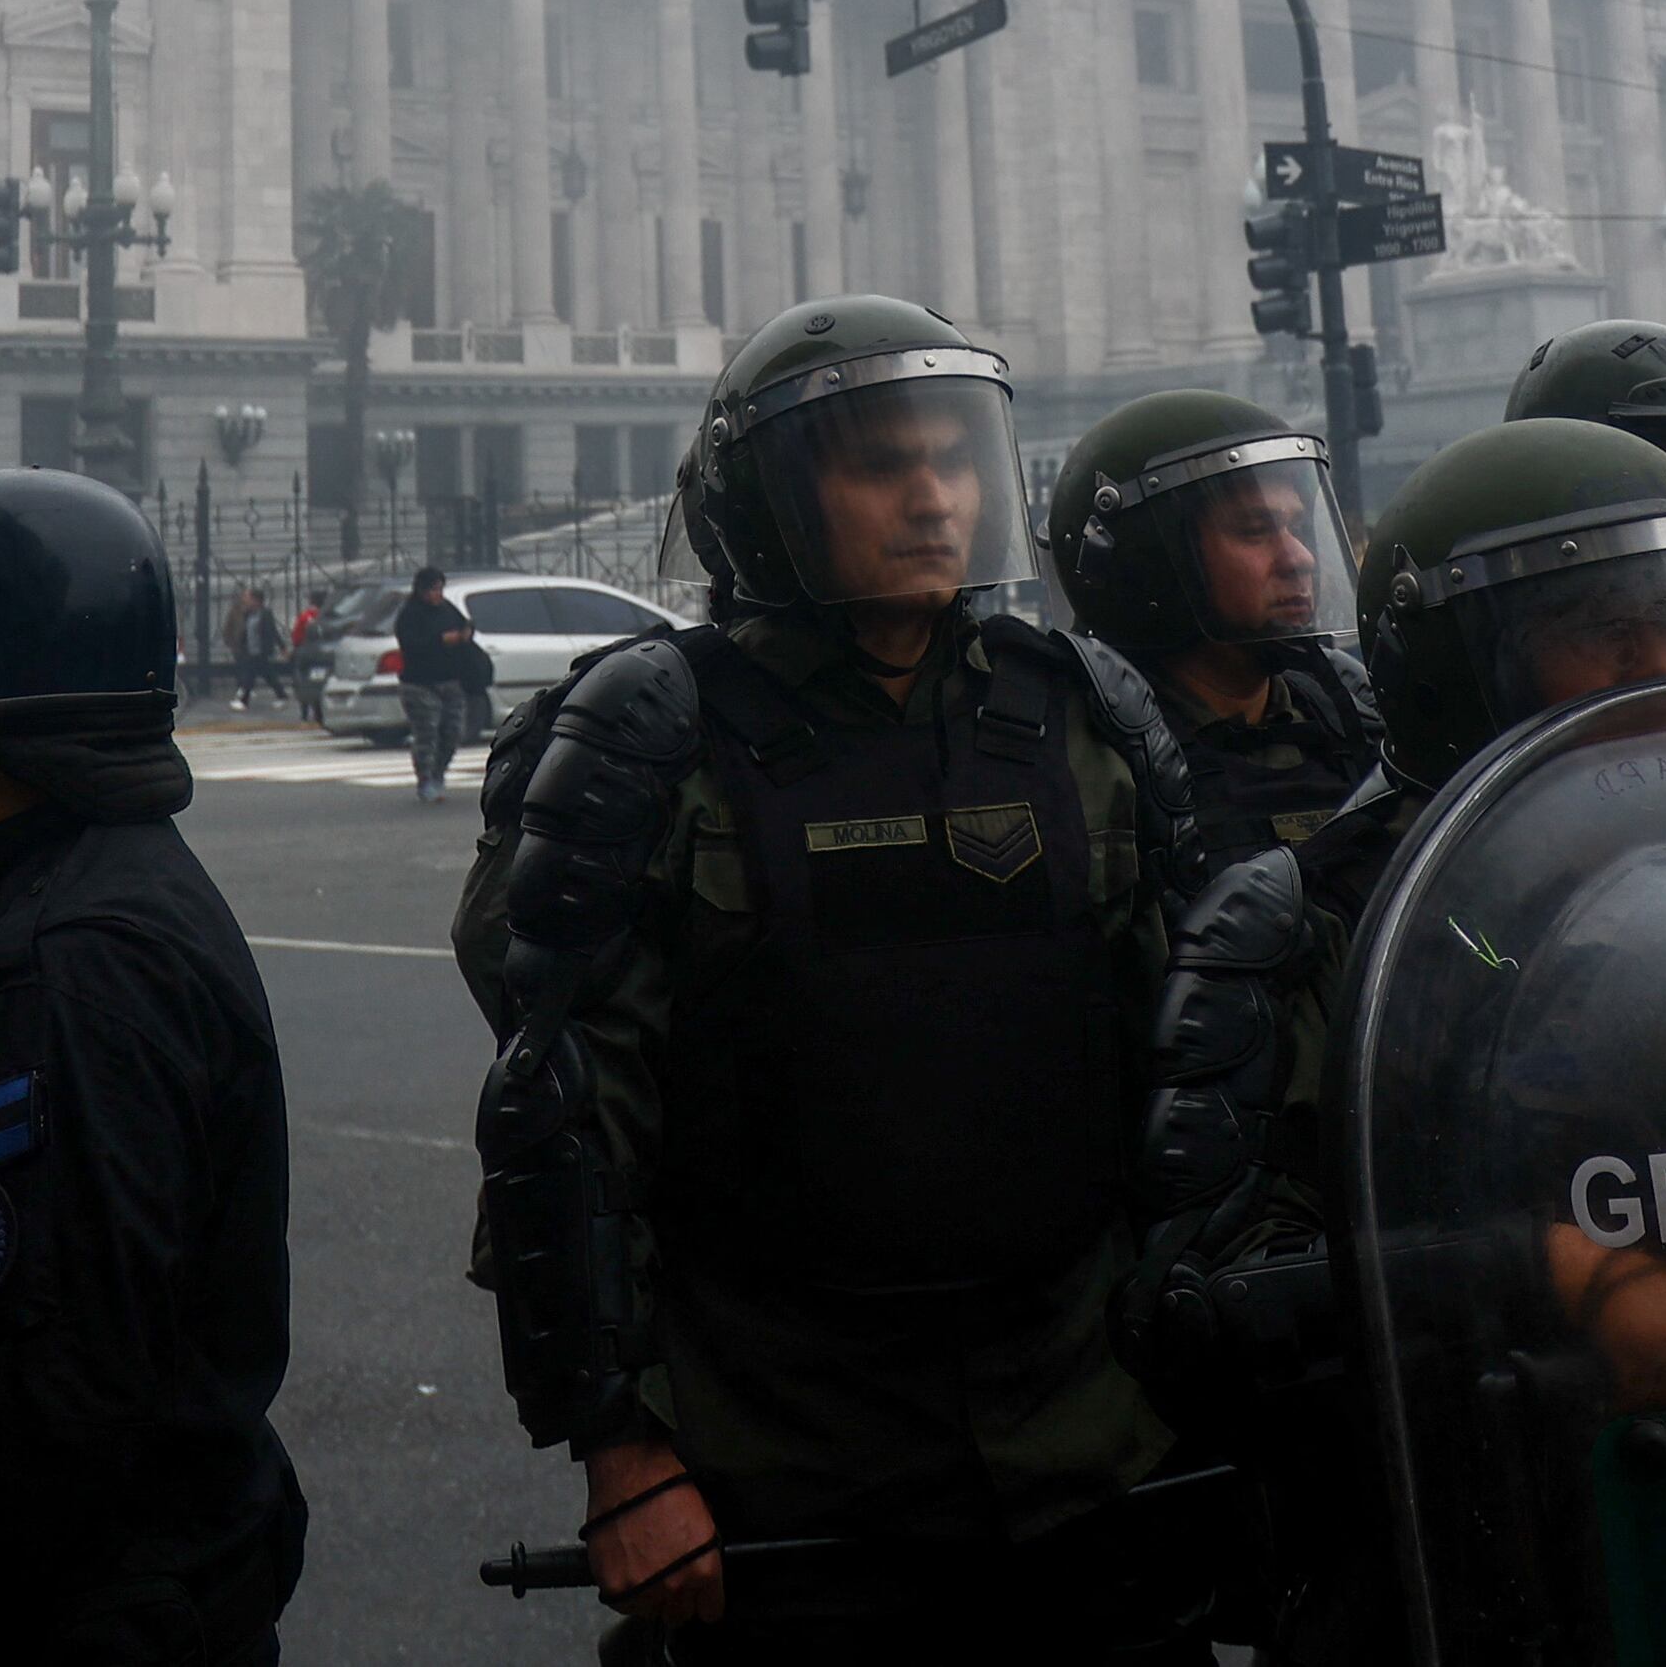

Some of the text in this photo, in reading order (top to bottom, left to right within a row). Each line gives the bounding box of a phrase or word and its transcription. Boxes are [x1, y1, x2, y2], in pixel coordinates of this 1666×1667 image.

[1375, 155, 1419, 175] Avenida
[1382, 219, 1437, 238] Yrigoyen
[833, 823, 910, 846] MOLINA
